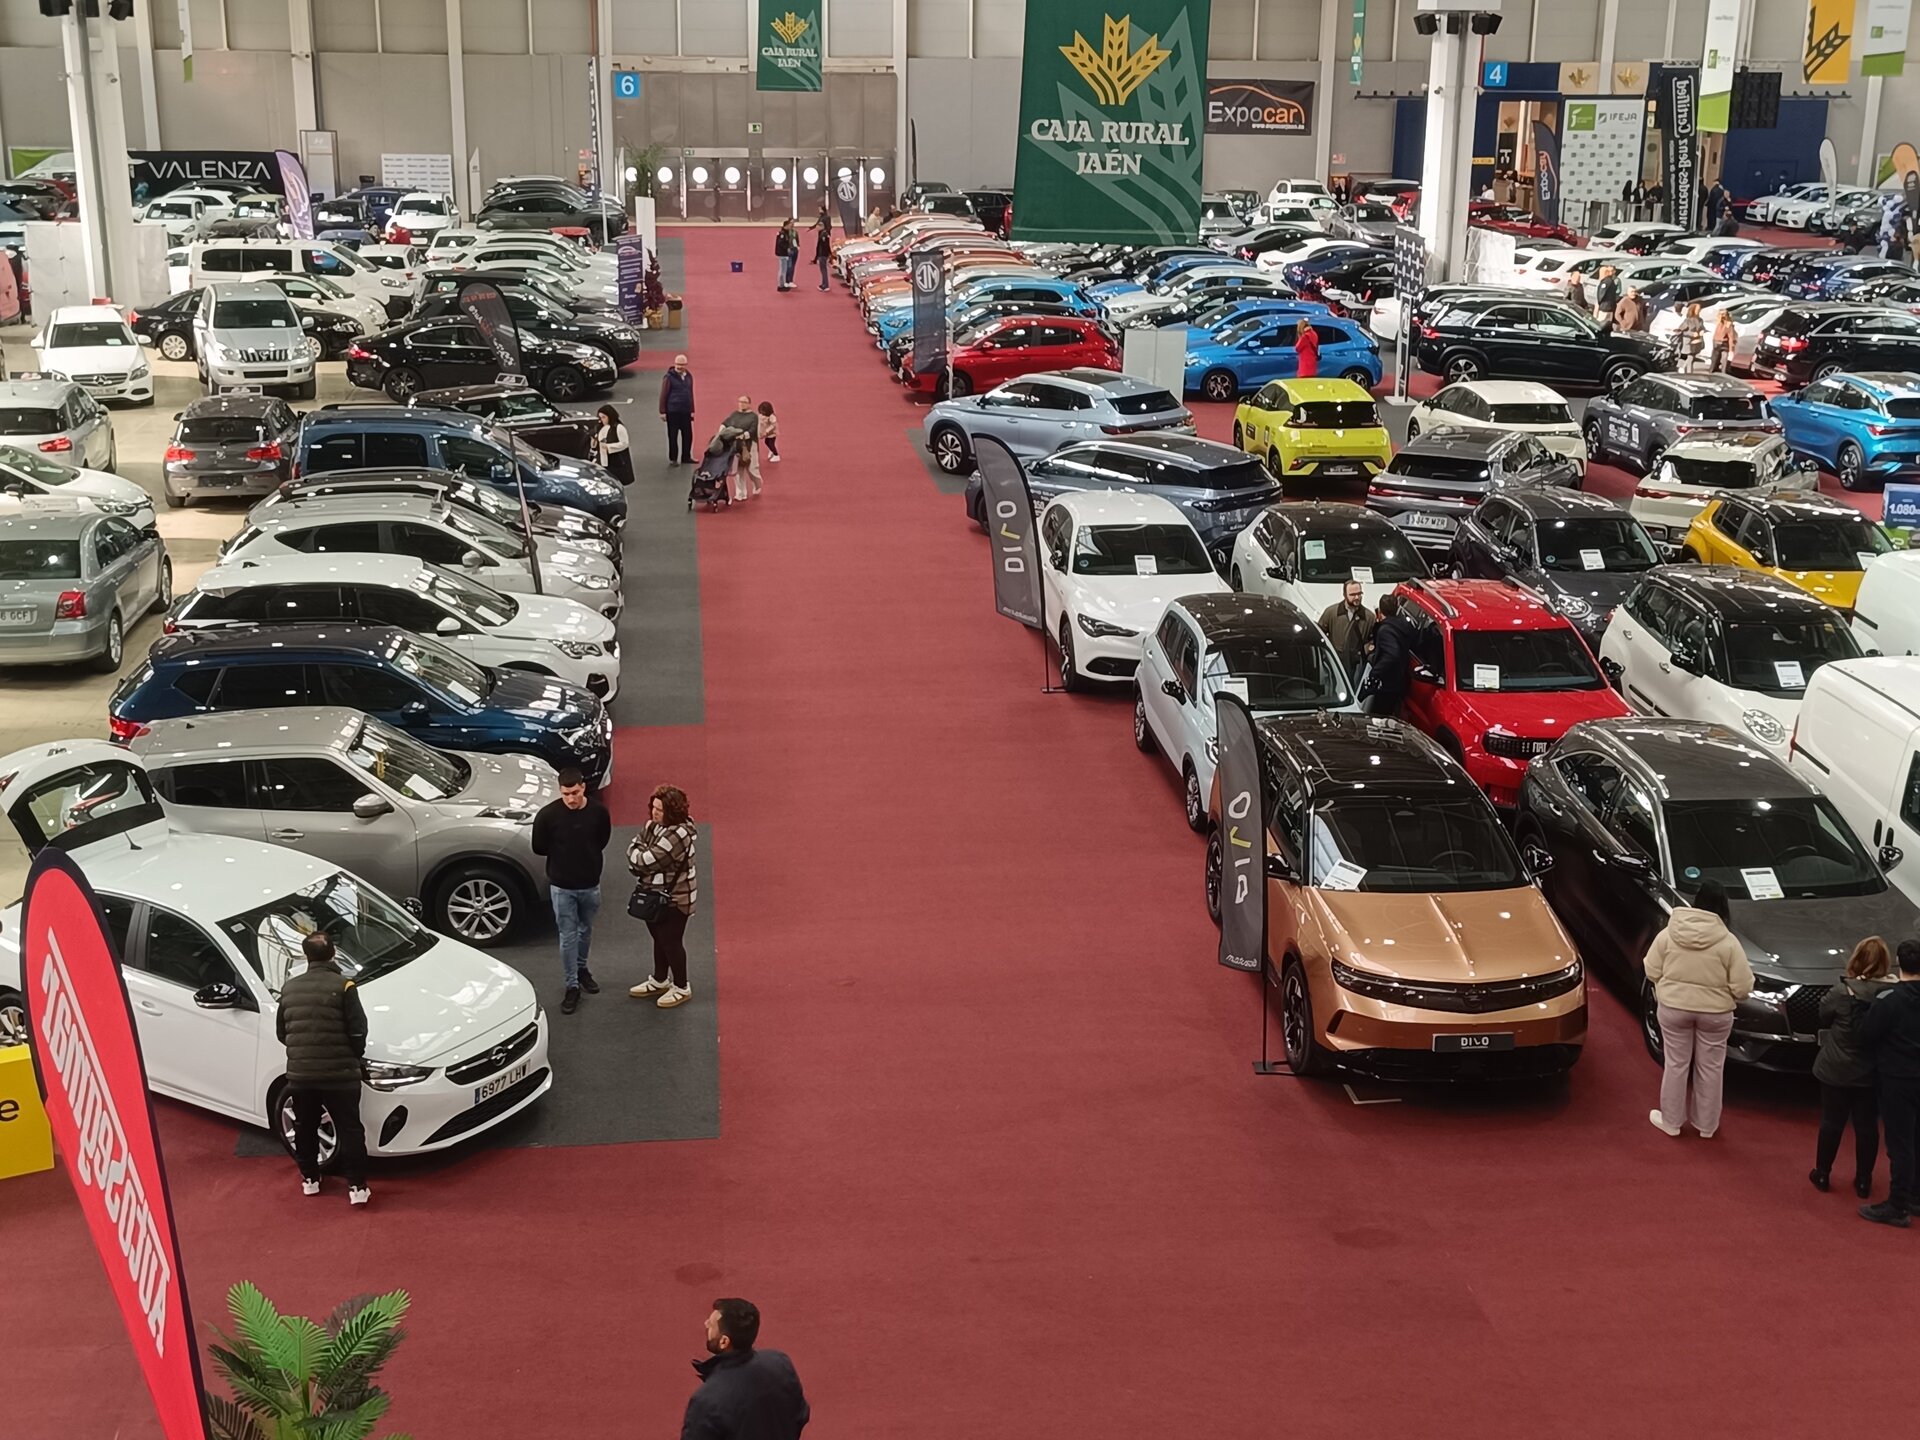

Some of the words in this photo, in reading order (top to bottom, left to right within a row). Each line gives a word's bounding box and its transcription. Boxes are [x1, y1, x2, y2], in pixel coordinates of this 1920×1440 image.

[621, 75, 635, 95] 6
[1489, 64, 1502, 84] 4
[1208, 101, 1298, 127] Expocar
[1031, 119, 1095, 143] CAJA
[1101, 121, 1189, 146] RURAL
[148, 160, 271, 181] VALENZA
[1076, 149, 1142, 175] JAÉN
[481, 1075, 507, 1099] 6977
